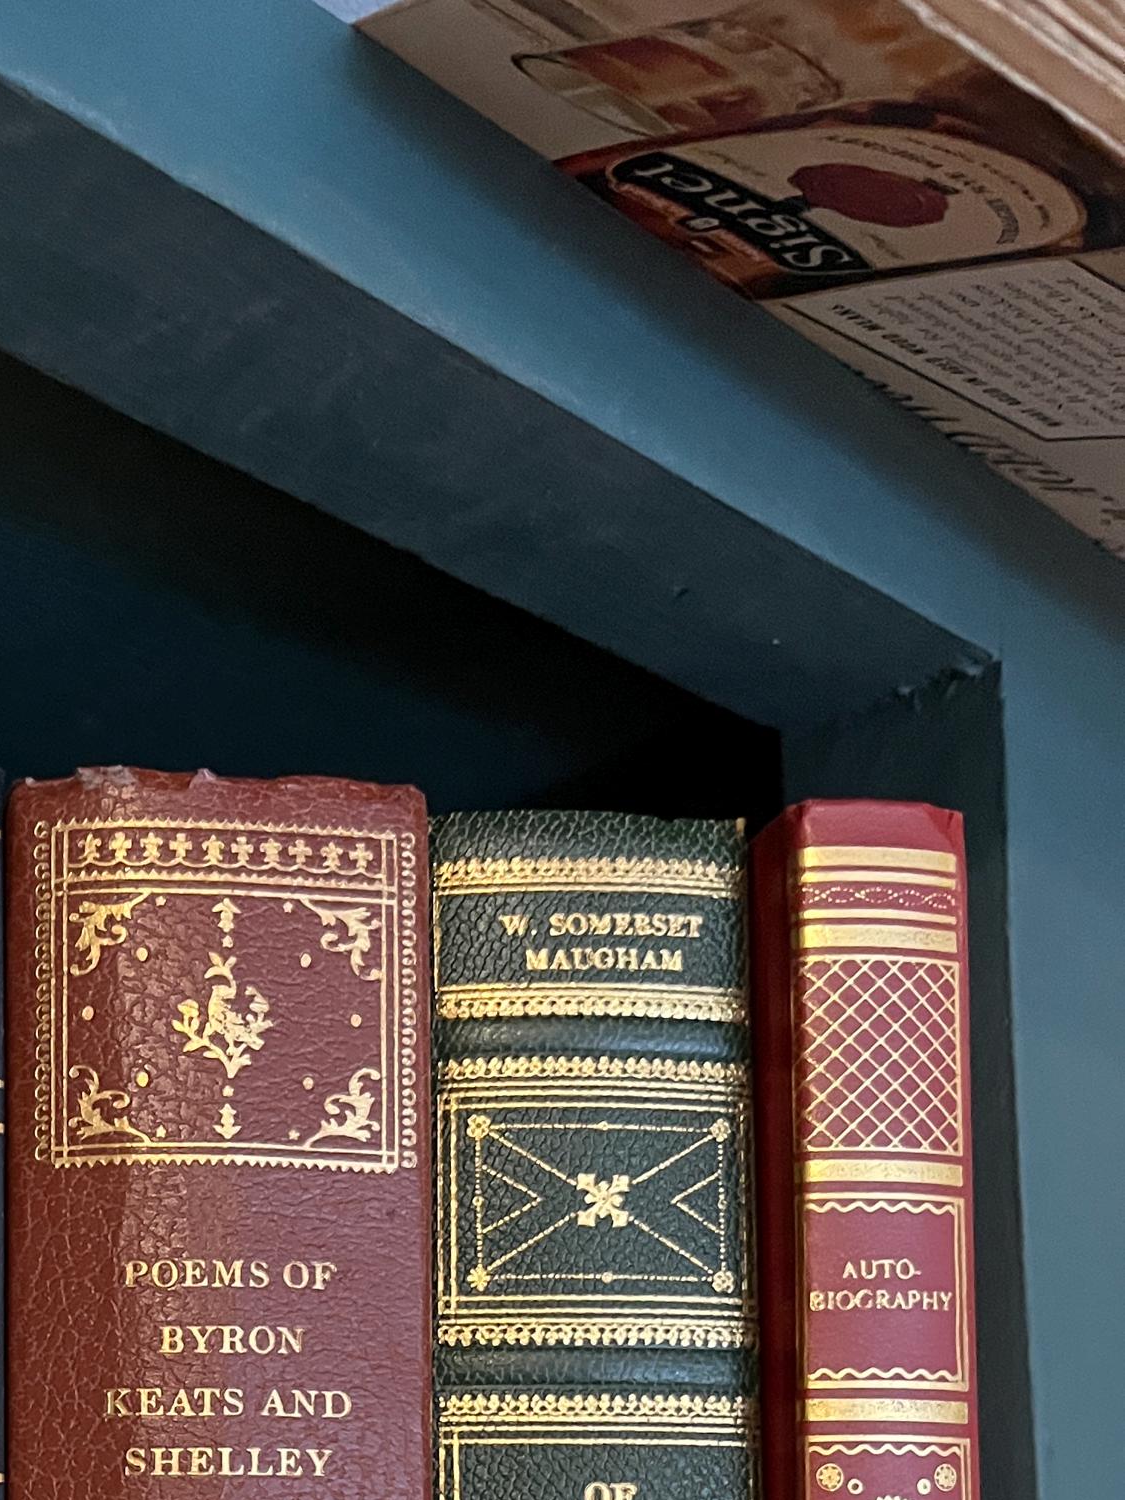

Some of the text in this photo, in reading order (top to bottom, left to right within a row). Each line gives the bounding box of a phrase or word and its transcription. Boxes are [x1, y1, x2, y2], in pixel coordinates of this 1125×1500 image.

[632, 162, 853, 268] Signet
[499, 913, 703, 938] W. SOMERSET
[525, 947, 683, 971] MAUGHAM
[125, 1259, 338, 1290] POEMS OF
[842, 1258, 922, 1280] AUTO-
[809, 1289, 953, 1312] BIOGRAPHY
[159, 1326, 305, 1354] BYRON
[104, 1388, 353, 1418] KEATS AND
[125, 1448, 333, 1477] SHELLEY
